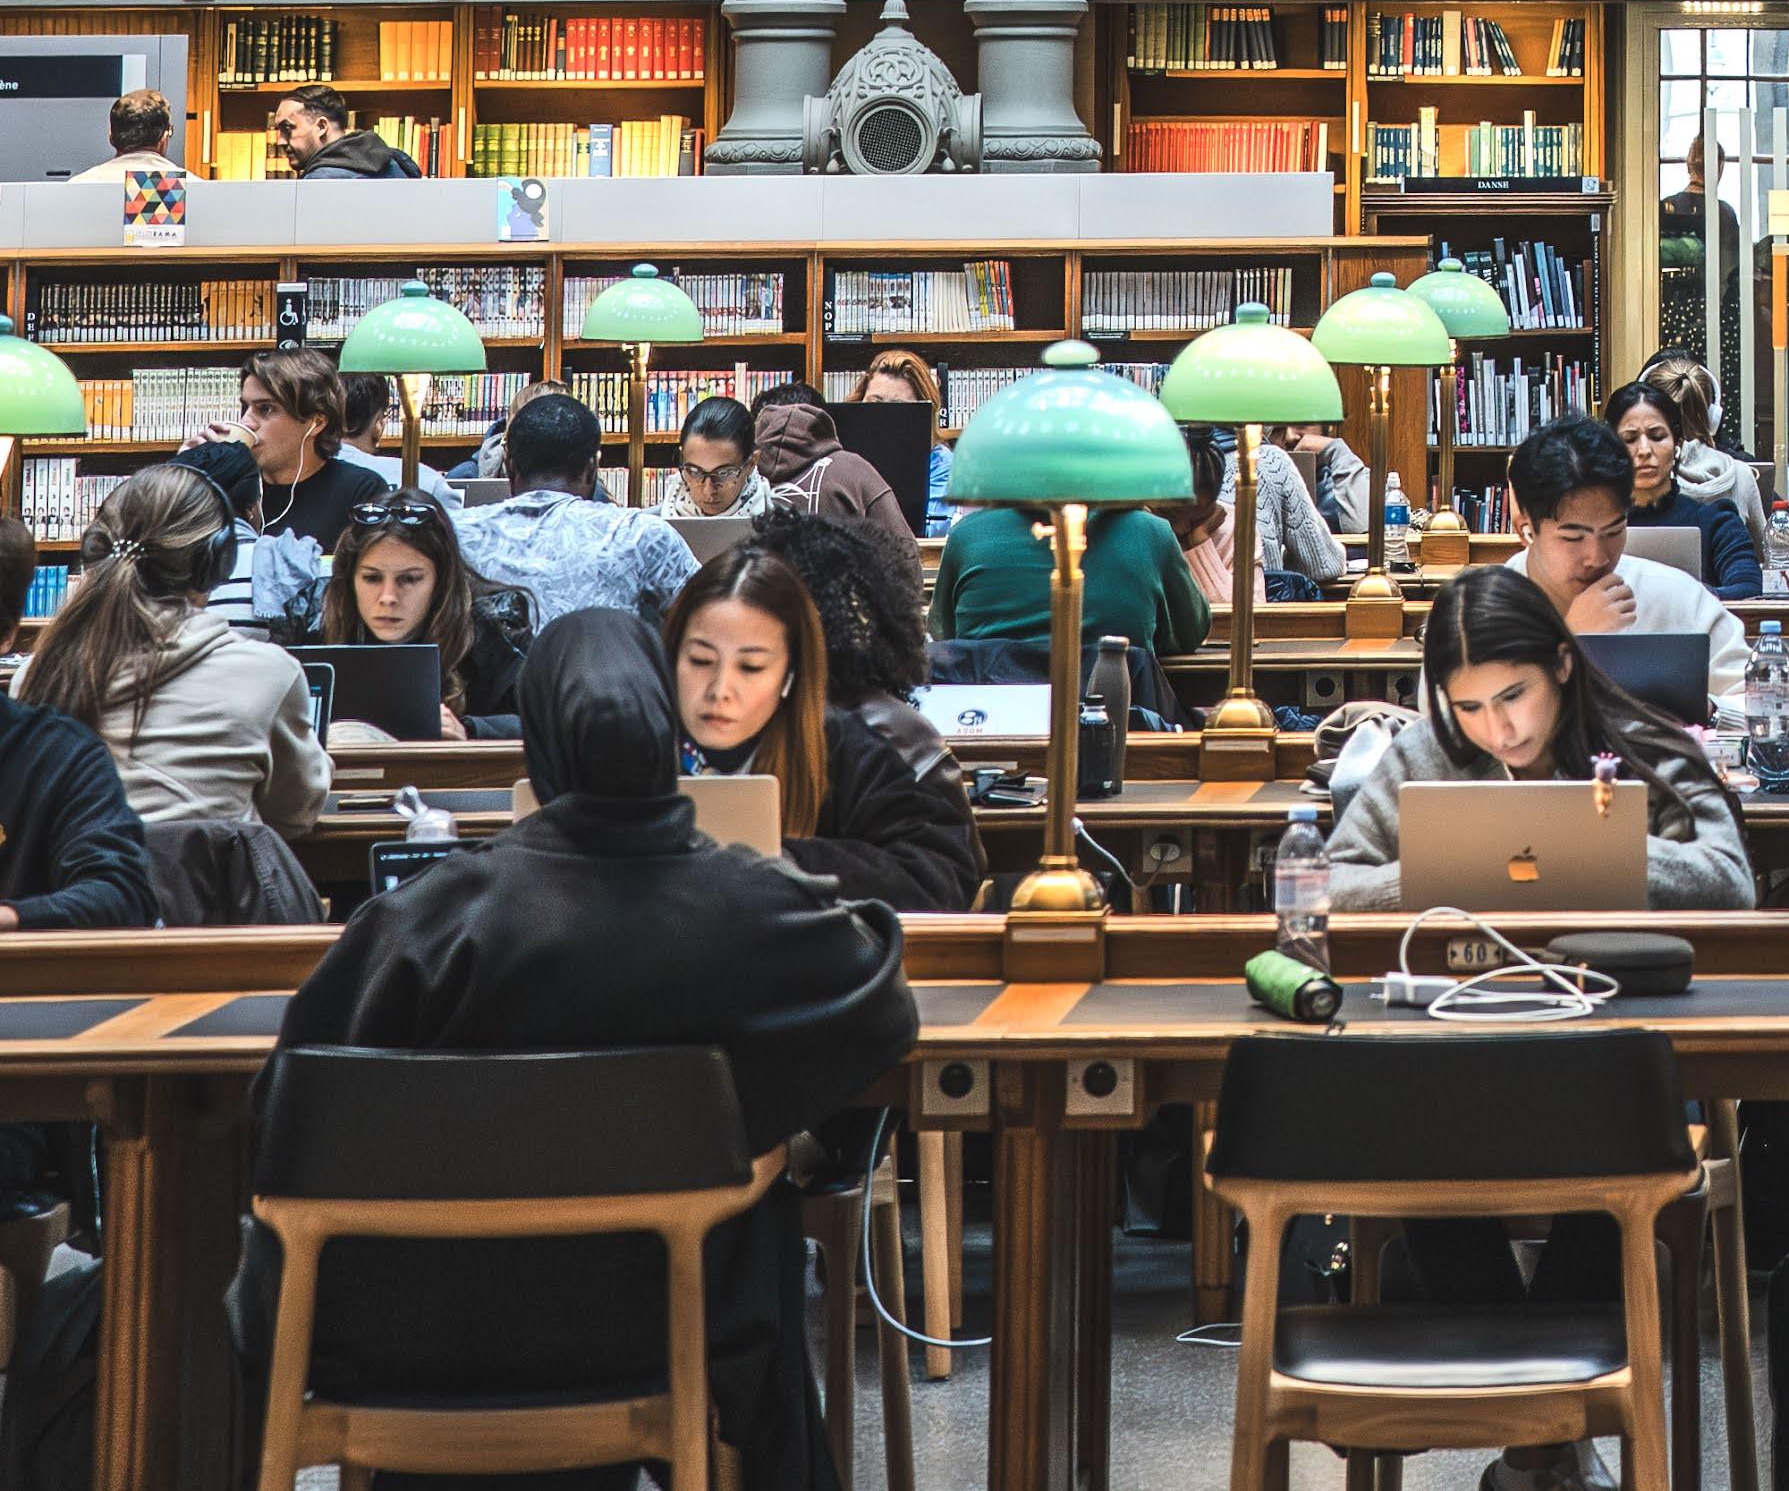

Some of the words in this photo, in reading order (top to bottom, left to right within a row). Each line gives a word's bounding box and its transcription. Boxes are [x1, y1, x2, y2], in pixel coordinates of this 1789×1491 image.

[0, 79, 19, 90] ène
[1477, 180, 1509, 189] DANSE
[1464, 942, 1487, 964] 60
